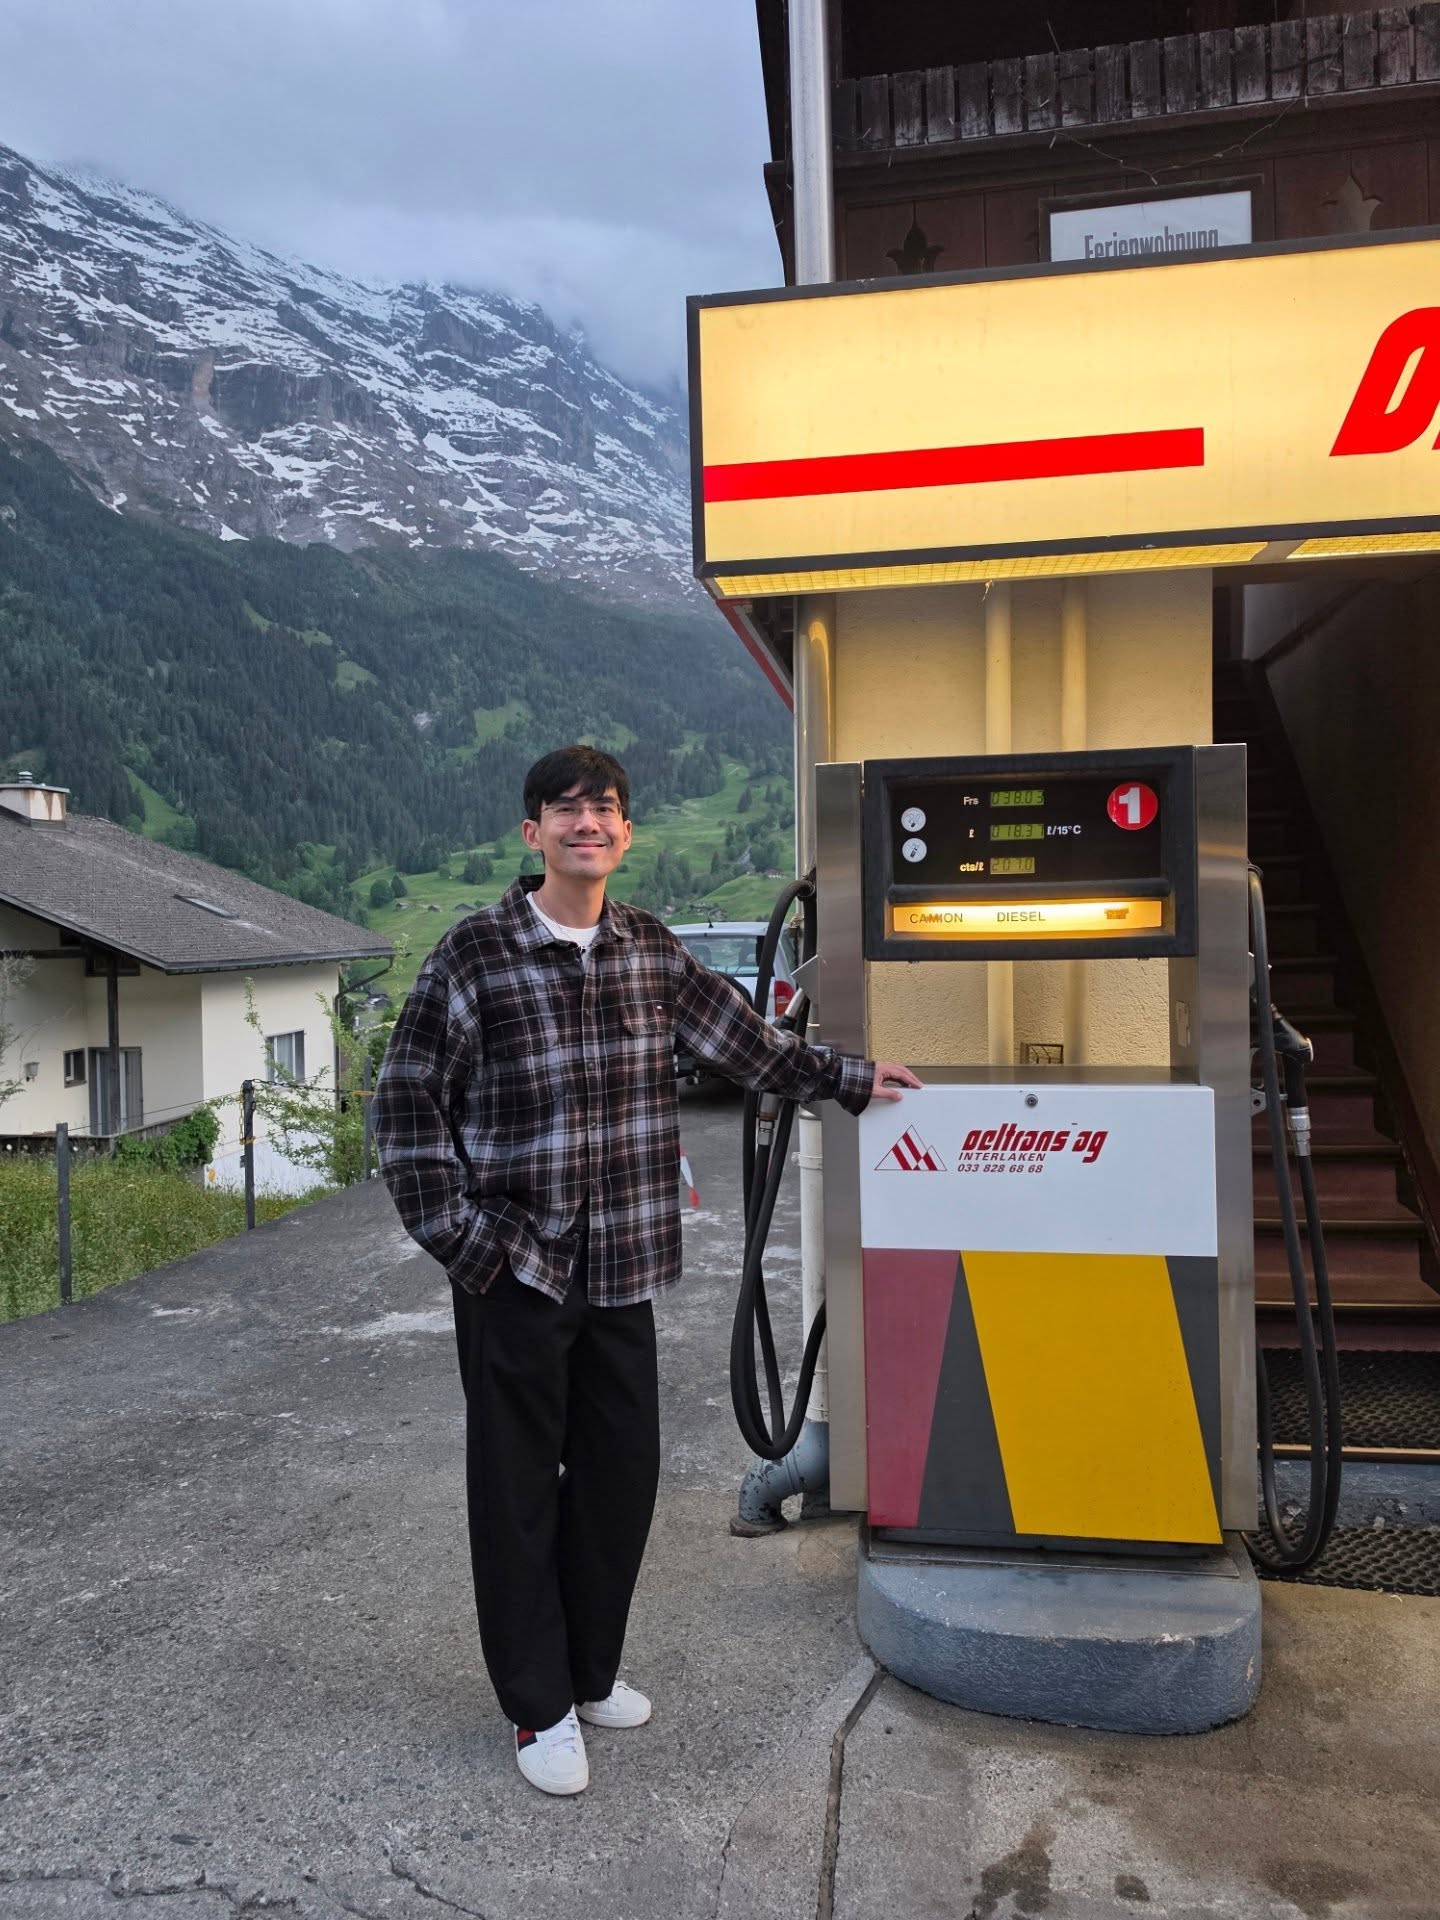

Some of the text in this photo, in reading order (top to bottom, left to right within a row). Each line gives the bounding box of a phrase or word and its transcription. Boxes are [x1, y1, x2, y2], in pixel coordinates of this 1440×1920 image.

[963, 796, 979, 806] Frs
[1119, 787, 1140, 824] 1
[909, 911, 1046, 924] CAMION DIESEL
[1071, 1131, 1109, 1163] ag
[958, 1152, 1046, 1162] INTERLAKEN
[957, 1163, 1044, 1173] 033 828 68 68
